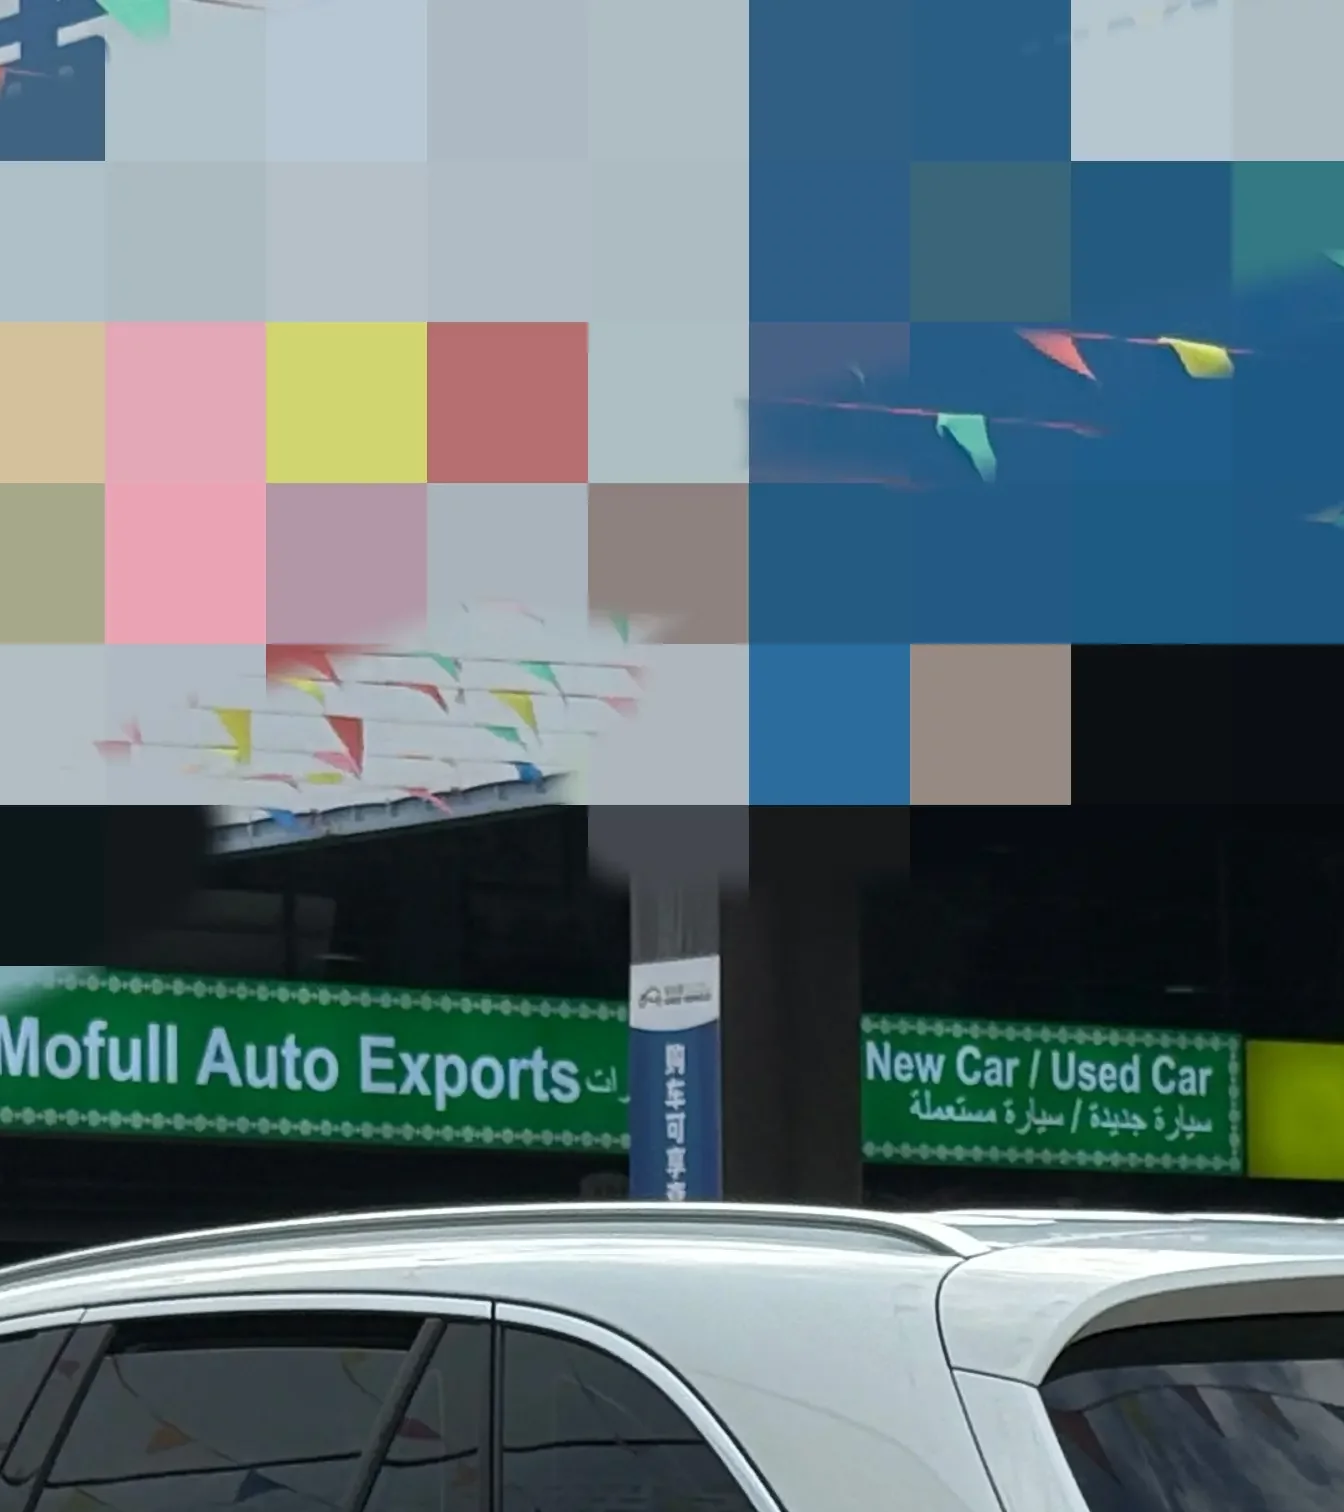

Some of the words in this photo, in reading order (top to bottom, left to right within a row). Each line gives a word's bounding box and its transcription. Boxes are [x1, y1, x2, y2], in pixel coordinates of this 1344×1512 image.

[196, 1027, 340, 1094] Auto
[359, 1034, 581, 1111] Exports
[865, 1040, 946, 1084] New
[956, 1045, 1020, 1088] Car
[1028, 1049, 1042, 1090] /
[1051, 1050, 1141, 1094] Used
[1152, 1055, 1214, 1097] Car
[909, 1089, 998, 1124] مستعملة
[1004, 1096, 1065, 1136] سيارة
[1089, 1102, 1148, 1137] جديدة
[1154, 1104, 1213, 1142] سيارة
